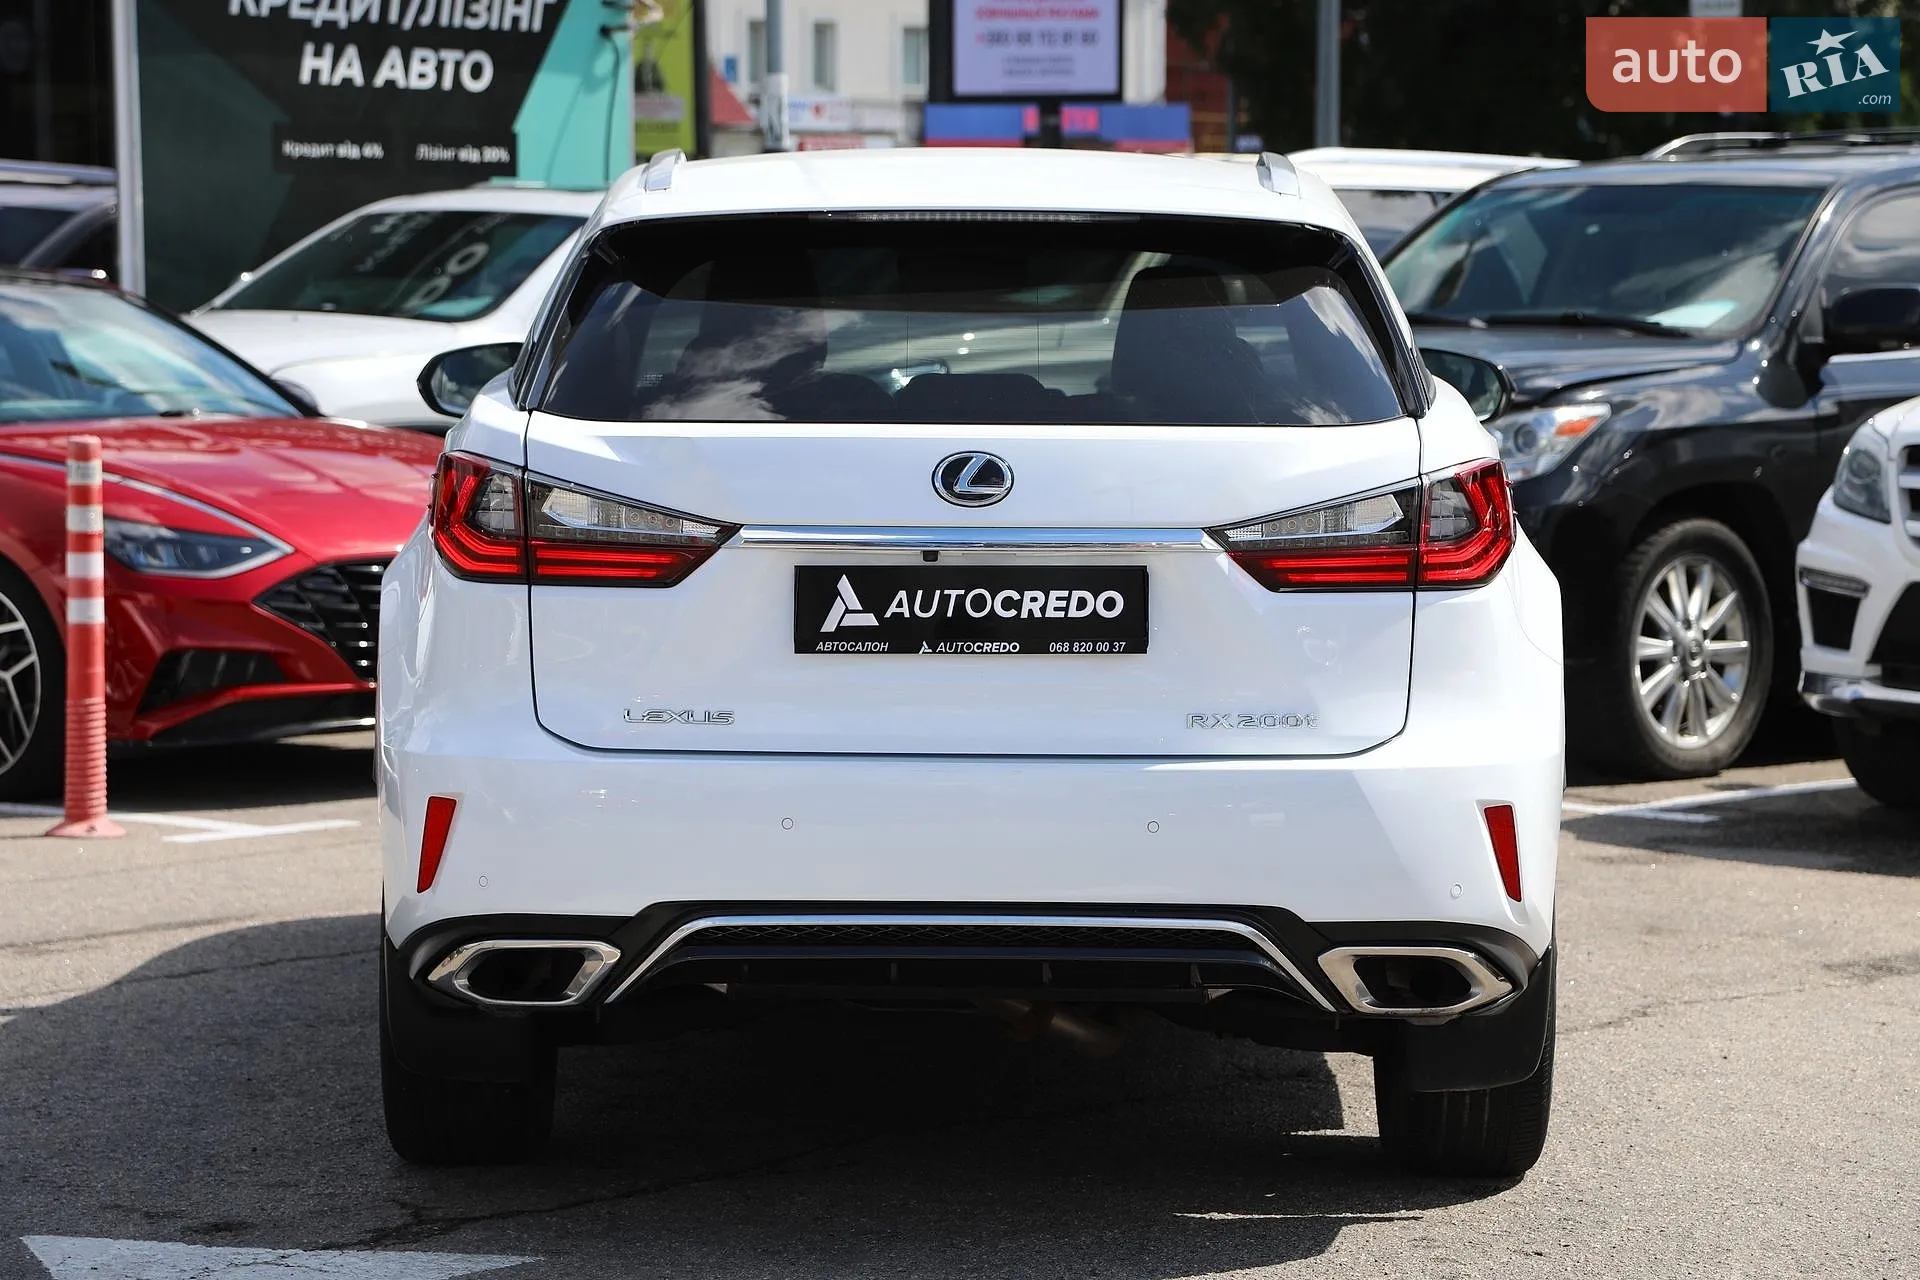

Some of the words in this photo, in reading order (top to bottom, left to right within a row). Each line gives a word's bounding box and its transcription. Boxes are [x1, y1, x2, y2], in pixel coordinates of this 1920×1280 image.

[299, 41, 365, 87] НА
[372, 44, 494, 93] АВТО
[884, 588, 1124, 618] AUTOCREDO
[815, 641, 889, 652] АВТОСАЛОН
[936, 642, 1020, 653] AUTOCREDO
[1049, 642, 1069, 653] 068
[1072, 642, 1093, 653] 820
[1095, 642, 1110, 653] 00
[1112, 641, 1126, 653] 37
[623, 708, 735, 725] LEXUS
